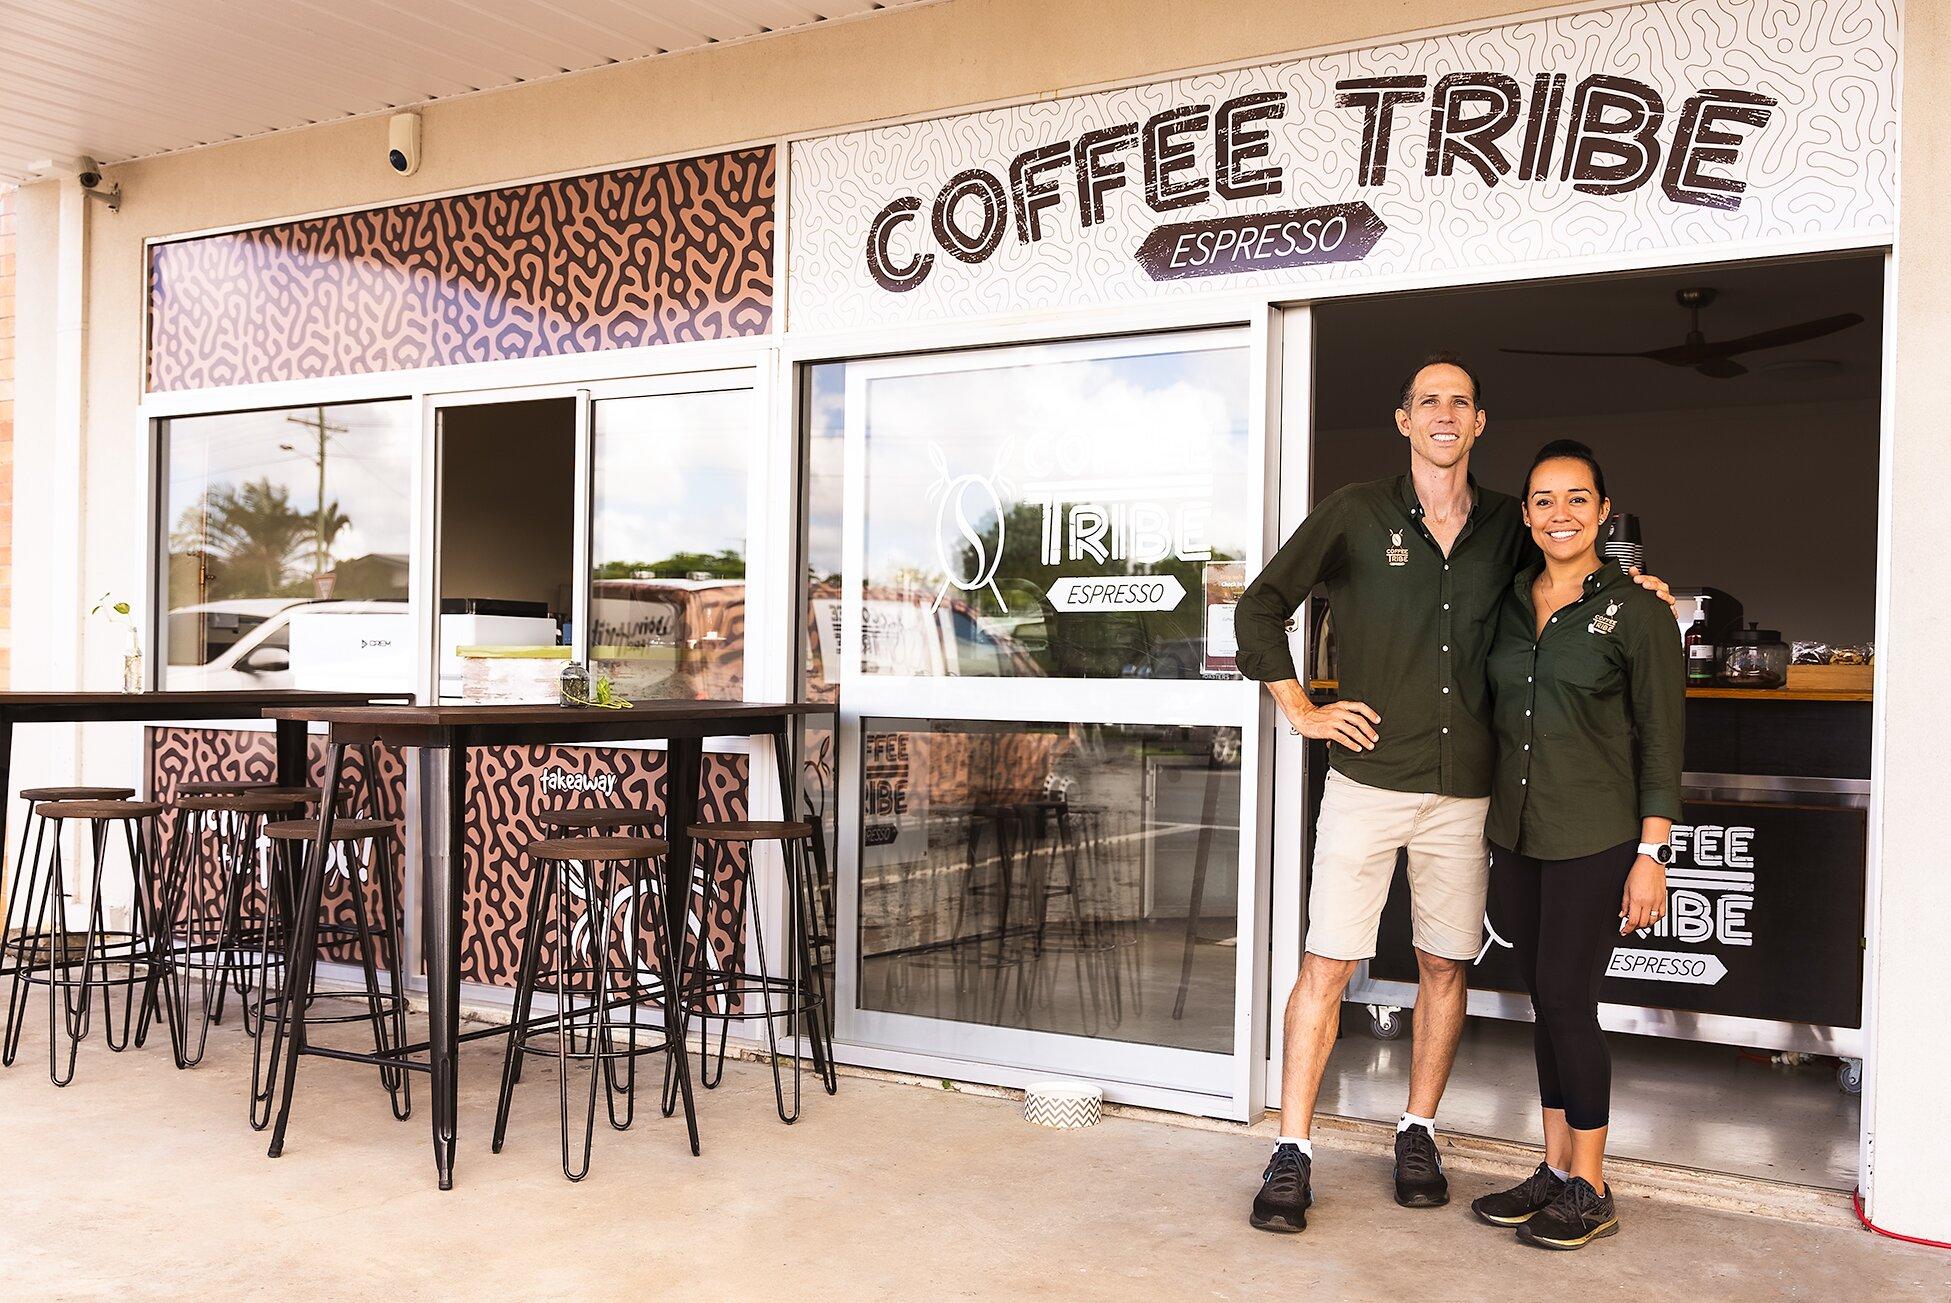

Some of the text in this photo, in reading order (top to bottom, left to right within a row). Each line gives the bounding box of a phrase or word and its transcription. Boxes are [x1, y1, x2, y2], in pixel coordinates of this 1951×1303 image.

[866, 71, 1778, 292] COFFEE TRIBE
[1169, 215, 1348, 269] ESPRESSO
[1023, 490, 1212, 566] TRIBE
[1067, 583, 1164, 604] ESPRESSO
[866, 733, 909, 762] FFEE
[540, 767, 617, 796] takeaway
[1669, 825, 1755, 868] FEE
[1610, 954, 1706, 977] ESPRESSO
